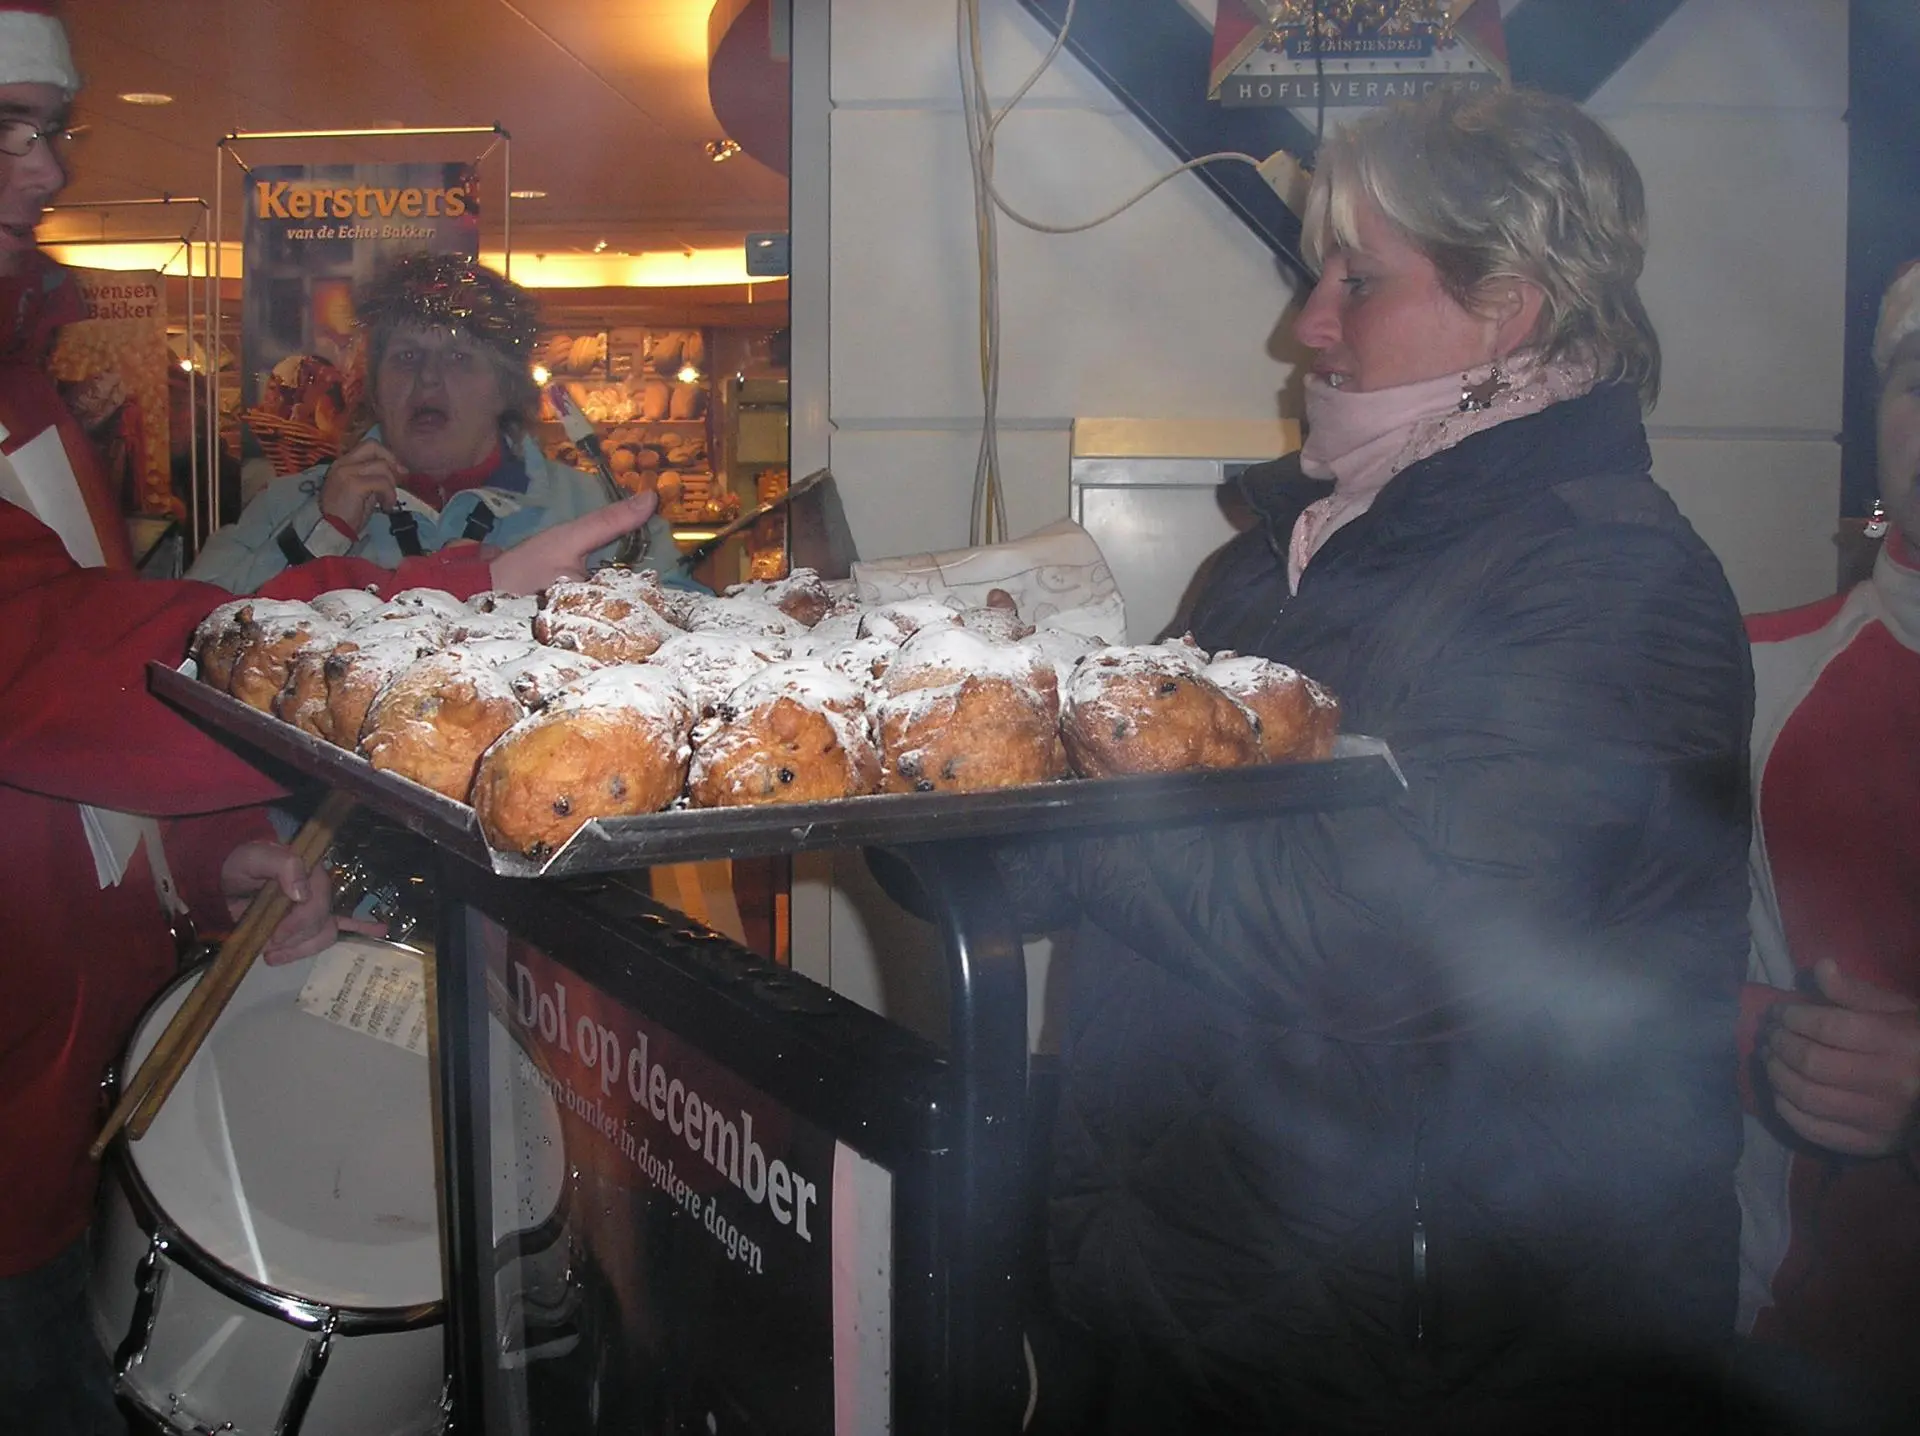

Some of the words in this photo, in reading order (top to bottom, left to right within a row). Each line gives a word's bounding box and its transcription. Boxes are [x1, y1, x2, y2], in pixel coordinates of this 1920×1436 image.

[1239, 79, 1481, 99] HOFLEVERANCER
[256, 181, 466, 219] Kerstvers
[287, 228, 314, 240] van
[317, 225, 335, 239] de
[338, 225, 379, 239] Echte
[87, 301, 155, 320] Bakker
[514, 961, 572, 1052] Dol
[576, 1015, 621, 1095] op
[627, 1031, 817, 1243] december
[620, 1119, 636, 1161] in
[637, 1137, 702, 1220] donkere
[704, 1197, 764, 1275] dagen
